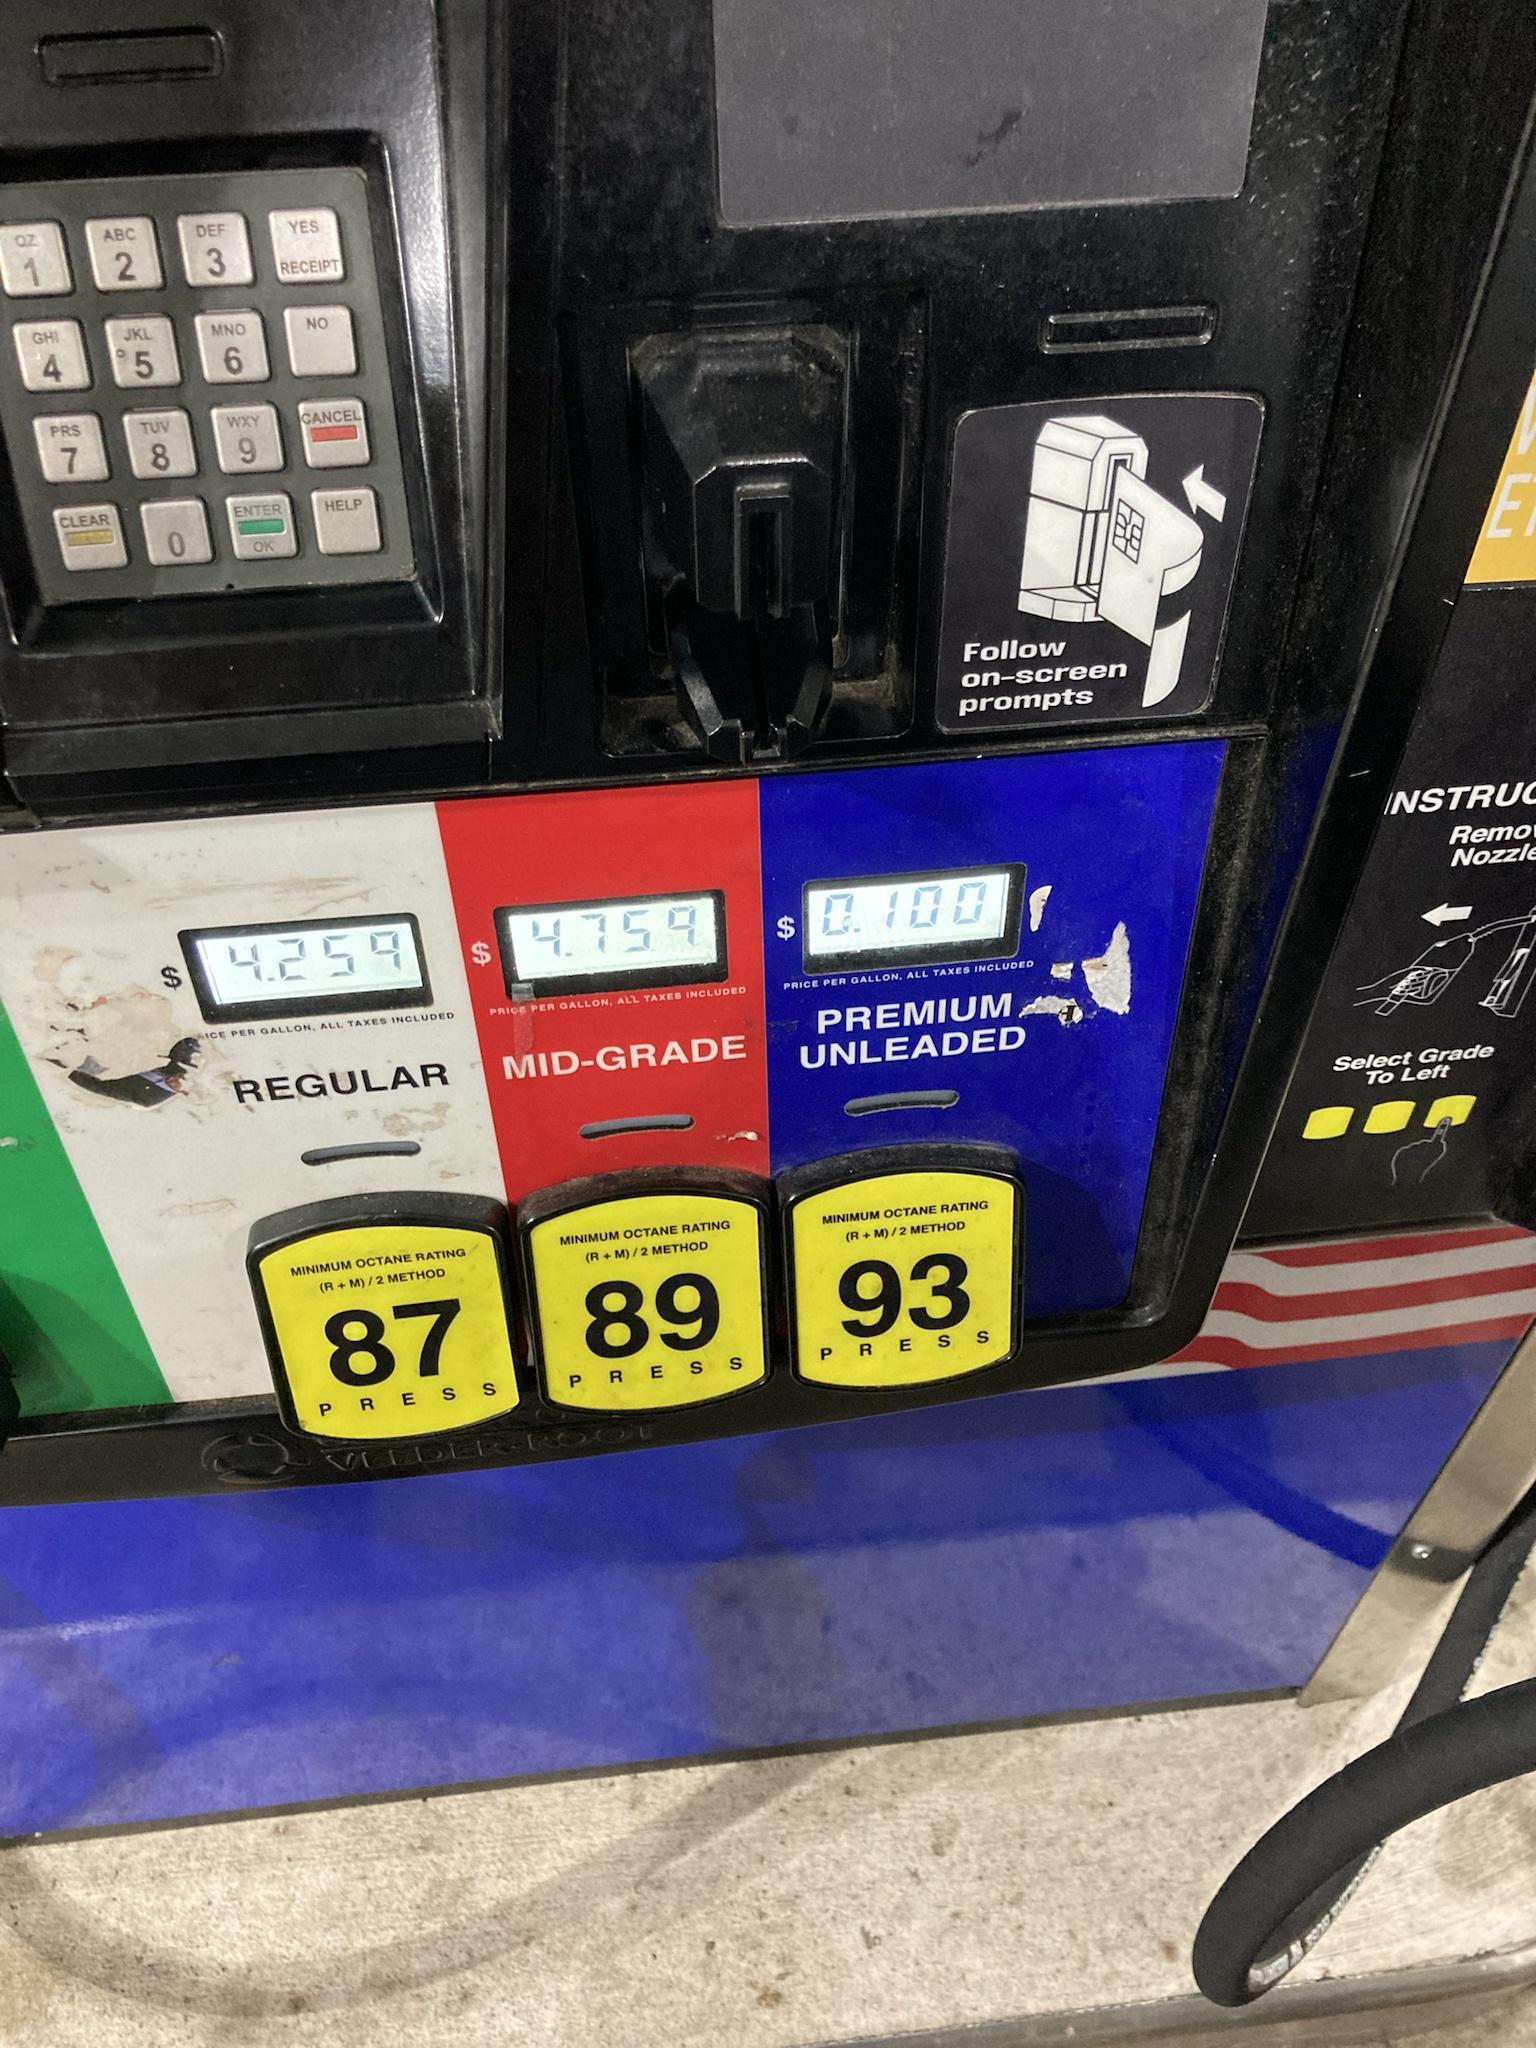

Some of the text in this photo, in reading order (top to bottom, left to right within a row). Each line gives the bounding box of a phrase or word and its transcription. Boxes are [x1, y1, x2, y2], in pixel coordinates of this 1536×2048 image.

[104, 228, 137, 242] ABC
[196, 224, 226, 238] DEF
[289, 220, 320, 234] YES
[15, 234, 37, 247] QZ
[23, 258, 41, 287] 1
[115, 252, 136, 281] 2
[207, 248, 226, 278] 3
[281, 259, 340, 275] RECEIPT
[124, 328, 153, 342] JKL
[211, 323, 246, 337] MNO
[306, 317, 329, 330] NO
[32, 331, 60, 345] GHI
[43, 354, 62, 383] 4
[135, 351, 154, 380] 5
[224, 347, 244, 375] 6
[141, 421, 171, 434] TUV
[227, 415, 261, 430] WXY
[301, 410, 362, 425] CANCEL
[50, 425, 81, 439] PRS
[61, 447, 77, 474] 7
[151, 443, 171, 471] 8
[238, 437, 258, 464] 9
[234, 504, 282, 518] ENTER
[325, 499, 363, 512] HELP
[59, 514, 110, 529] CLEAR
[168, 532, 186, 557] 0
[253, 540, 275, 553] OK
[963, 640, 1066, 662] Follow
[961, 662, 1128, 688] on-screen
[958, 688, 1094, 717] prompts
[1449, 824, 1536, 845] Remo
[471, 905, 696, 966] $ 4.759
[776, 915, 796, 940] $
[161, 930, 400, 989] $ 4.259
[783, 960, 1035, 990] PRICE PER GALLON, ALL TAXES INCLUDED
[489, 986, 747, 1016] PRICE PER GALLON, ALL TAXES INCLUDED
[817, 992, 1012, 1035] PREMIUM
[231, 1029, 256, 1038] PER
[260, 1024, 316, 1036] GALLON,
[320, 1021, 344, 1030] ALL
[348, 1017, 388, 1028] TAXES
[391, 1012, 455, 1024] INCLUDED
[502, 1035, 747, 1080] MID-GRADE
[800, 1026, 1027, 1069] UNLEADED
[1333, 1044, 1495, 1072] Select Grade
[232, 1063, 450, 1103] REGULAR
[1366, 1064, 1451, 1085] To Left
[822, 1200, 989, 1225] MINIMUM OCTANE RATING
[559, 1220, 732, 1246] MINIMUM OCTANE RATING
[910, 1221, 966, 1236] METHOD
[652, 1241, 709, 1256] METHOD
[290, 1248, 467, 1277] MINIMUM OCTANE RATING
[387, 1268, 446, 1284] METHOD
[838, 1253, 970, 1338] 93
[584, 1272, 721, 1359] 89
[324, 1298, 461, 1387] 87
